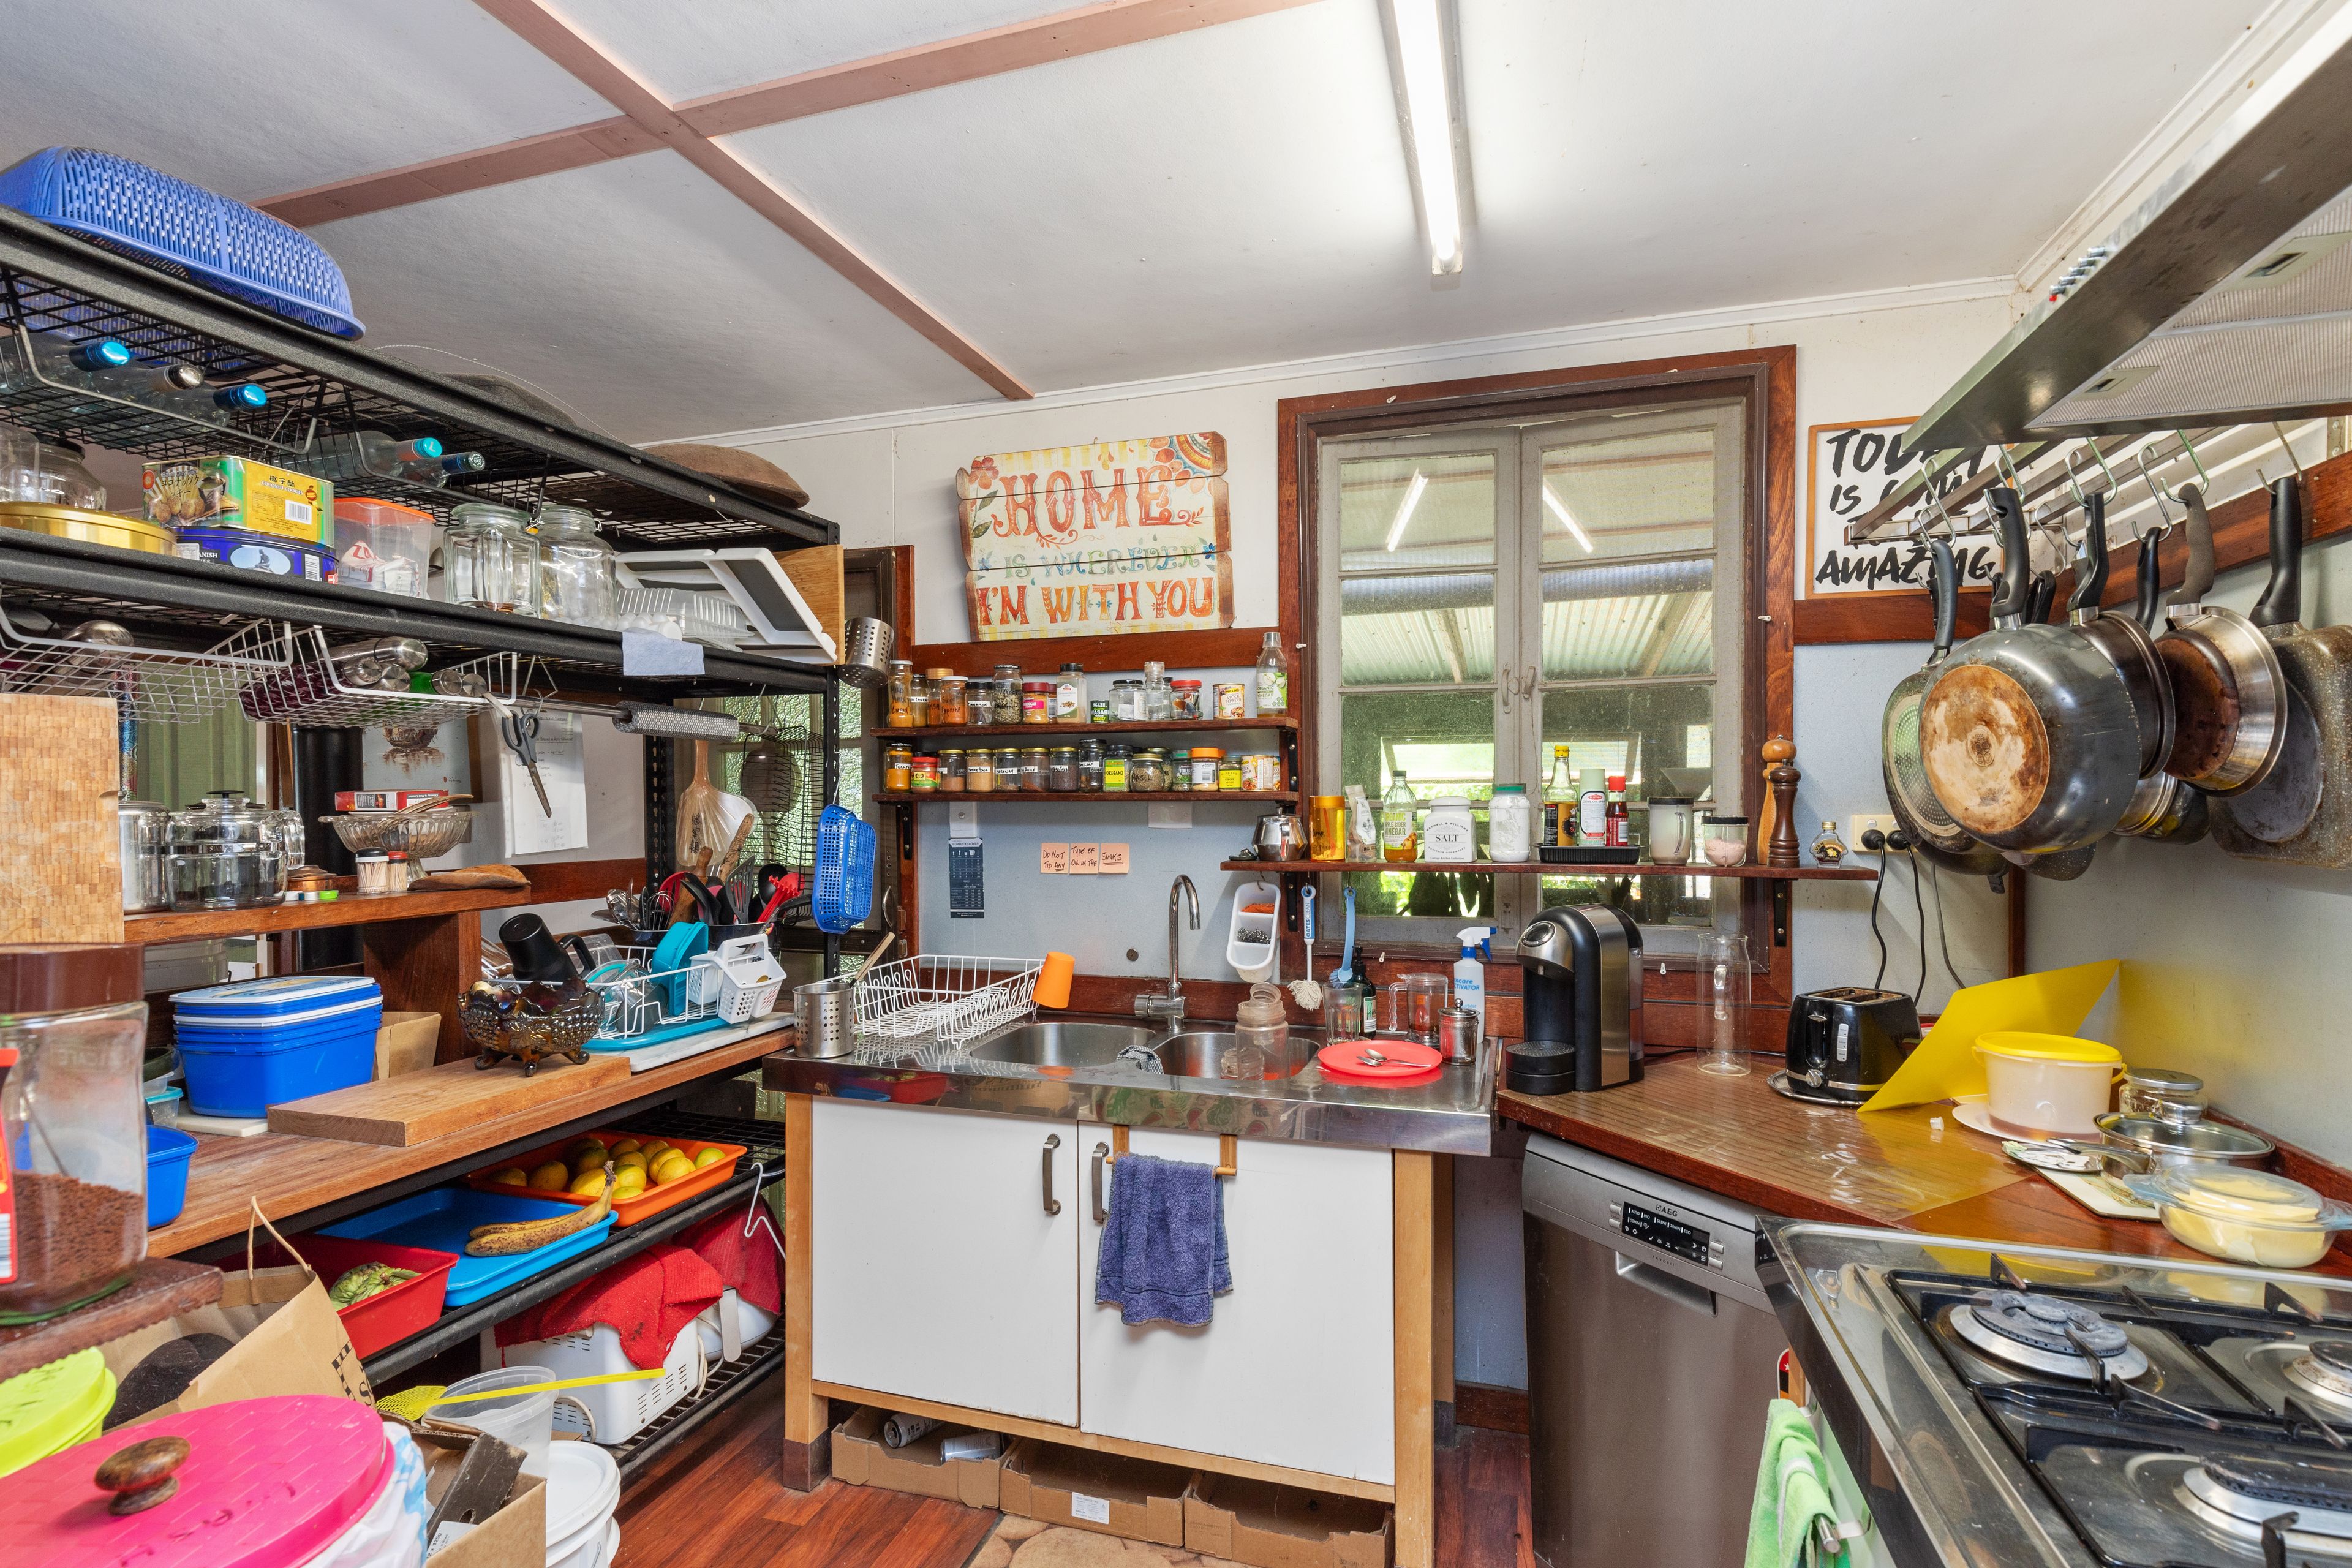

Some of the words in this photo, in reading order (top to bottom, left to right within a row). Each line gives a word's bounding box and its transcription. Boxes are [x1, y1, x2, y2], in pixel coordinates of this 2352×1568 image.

[261, 481, 284, 490] COCONUT
[284, 486, 304, 495] COOKIES
[997, 466, 1175, 537] HOME
[1830, 484, 1861, 514] IS
[1004, 554, 1032, 579] IS
[1041, 545, 1201, 577] WHEREVER
[978, 584, 1028, 626] I'M
[1041, 581, 1136, 624] WITH
[1146, 576, 1215, 619] YOU
[1132, 773, 1152, 782] BASIL
[1450, 823, 1468, 832] WILLIAMS
[1043, 850, 1050, 859] DO
[1052, 851, 1065, 859] NOT
[1102, 852, 1122, 861] SINKS
[1662, 1207, 1678, 1217] AEG
[1653, 1255, 1675, 1267] FAVORIT
